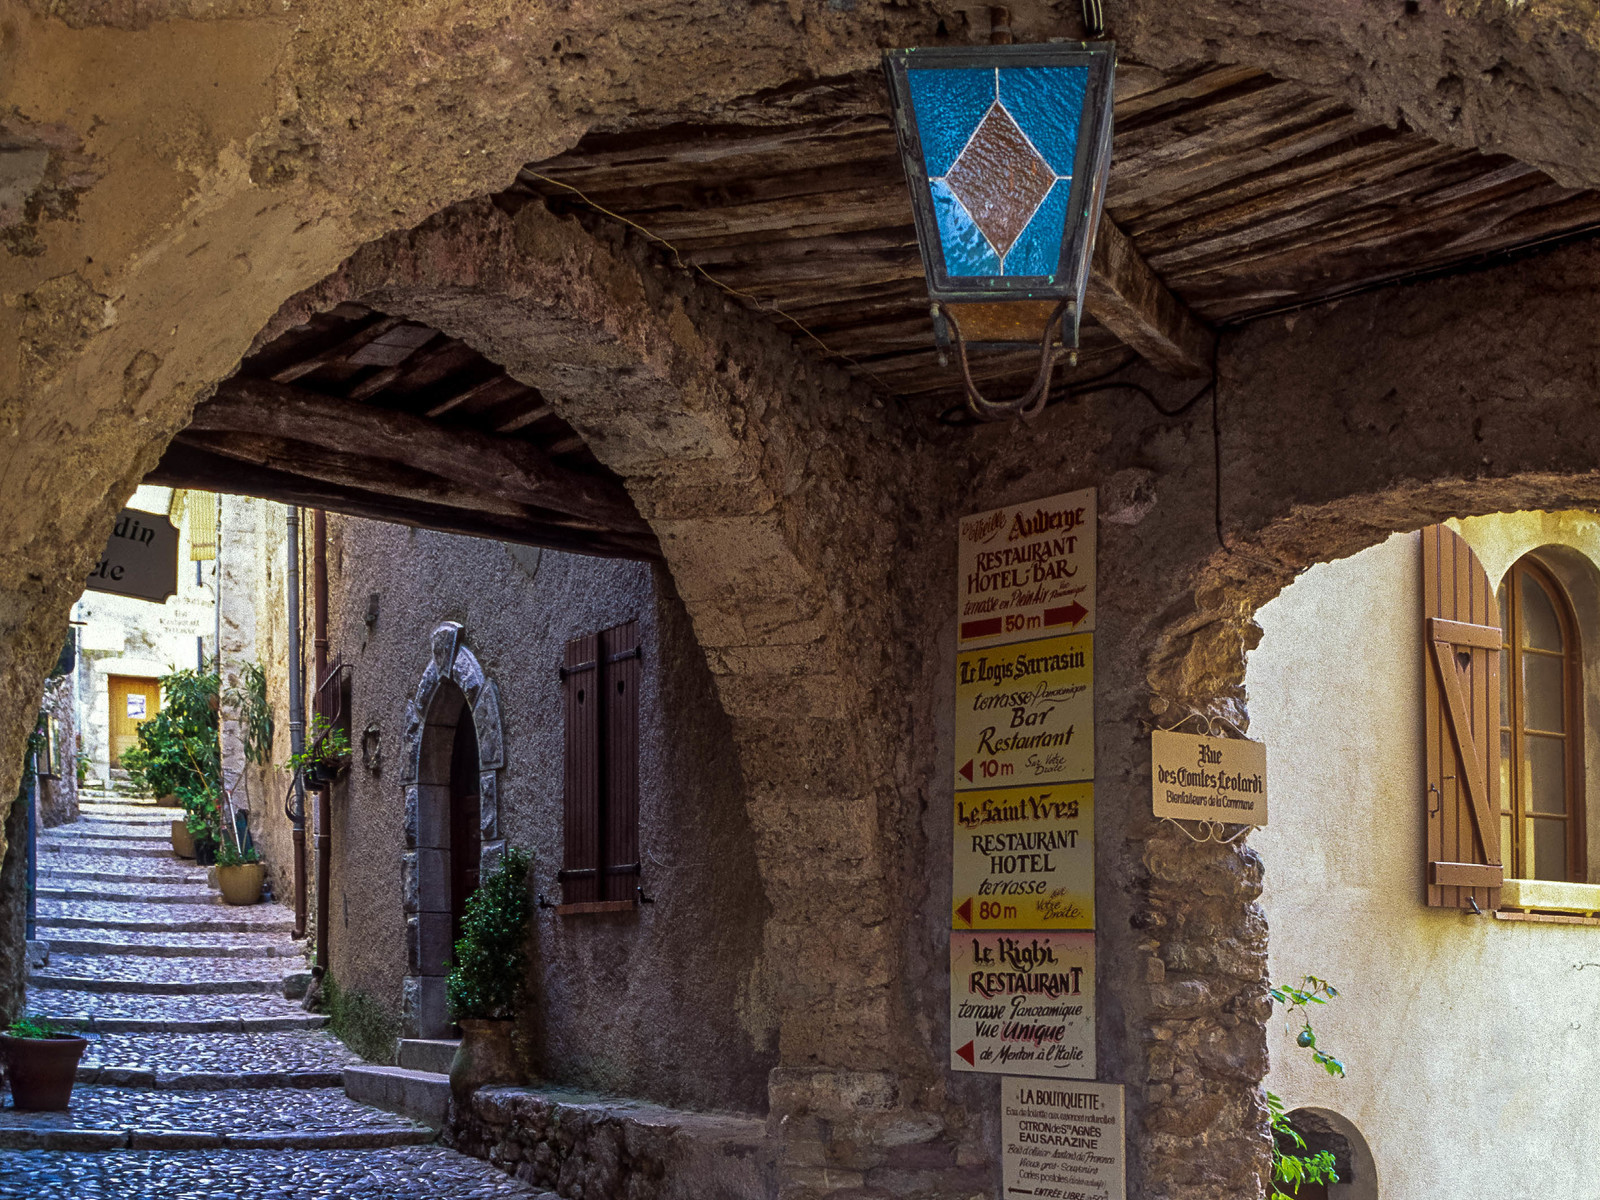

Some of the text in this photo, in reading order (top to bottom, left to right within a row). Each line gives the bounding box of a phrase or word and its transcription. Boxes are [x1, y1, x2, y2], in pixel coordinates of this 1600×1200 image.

[1008, 507, 1085, 541] Auberge
[976, 536, 1078, 572] RESTAURANT
[1005, 614, 1025, 632] 50
[960, 646, 1085, 686] Le Logis Sarrasin
[973, 690, 1033, 711] terrasse
[1010, 706, 1055, 728] Bar
[977, 724, 1074, 755] Restaurant
[1197, 744, 1223, 767] Rue
[980, 759, 1014, 778] 10 m
[1158, 765, 1177, 784] des
[1177, 766, 1217, 789] Comtes
[957, 793, 1079, 828] Le Saint Yves
[1222, 795, 1254, 811] Commune
[971, 830, 1078, 856] RESTAURANT
[990, 854, 1056, 874] HOTEL
[978, 878, 1047, 896] terrasse
[979, 901, 1017, 920] 80 m
[972, 937, 1058, 973] Le Righi
[969, 967, 1083, 1000] RESTAURANT
[958, 995, 1083, 1022] terrasse Panoramique
[975, 1020, 999, 1038] Vue
[979, 1046, 992, 1061] de
[991, 1045, 1034, 1064] Menton
[1020, 1089, 1099, 1110] LA BOUTIQUETTE
[1019, 1121, 1051, 1133] CITRON
[1020, 1132, 1098, 1149] EAU SARAZINE
[1062, 1191, 1085, 1200] LIBRE
